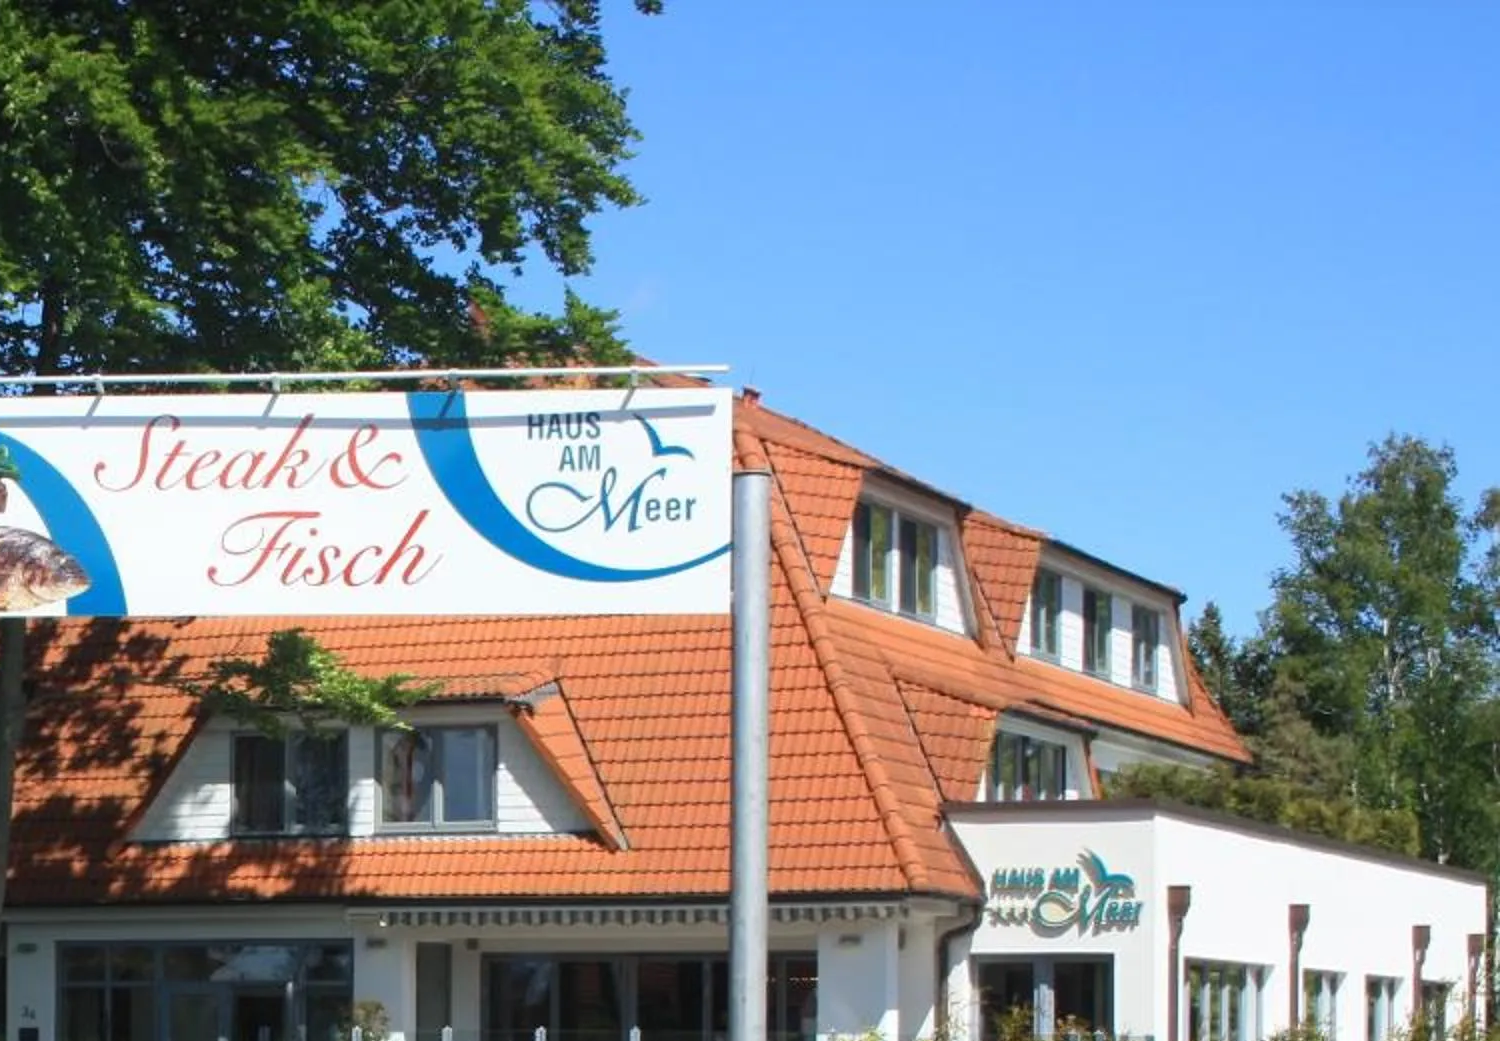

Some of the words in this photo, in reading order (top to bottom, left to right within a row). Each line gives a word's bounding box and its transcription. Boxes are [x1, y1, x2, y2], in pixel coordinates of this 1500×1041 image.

[94, 414, 328, 492] Steak
[329, 424, 409, 490] &
[527, 412, 600, 440] HAUS
[558, 445, 601, 471] AM
[526, 466, 697, 533] Meer
[207, 509, 444, 587] Fisch
